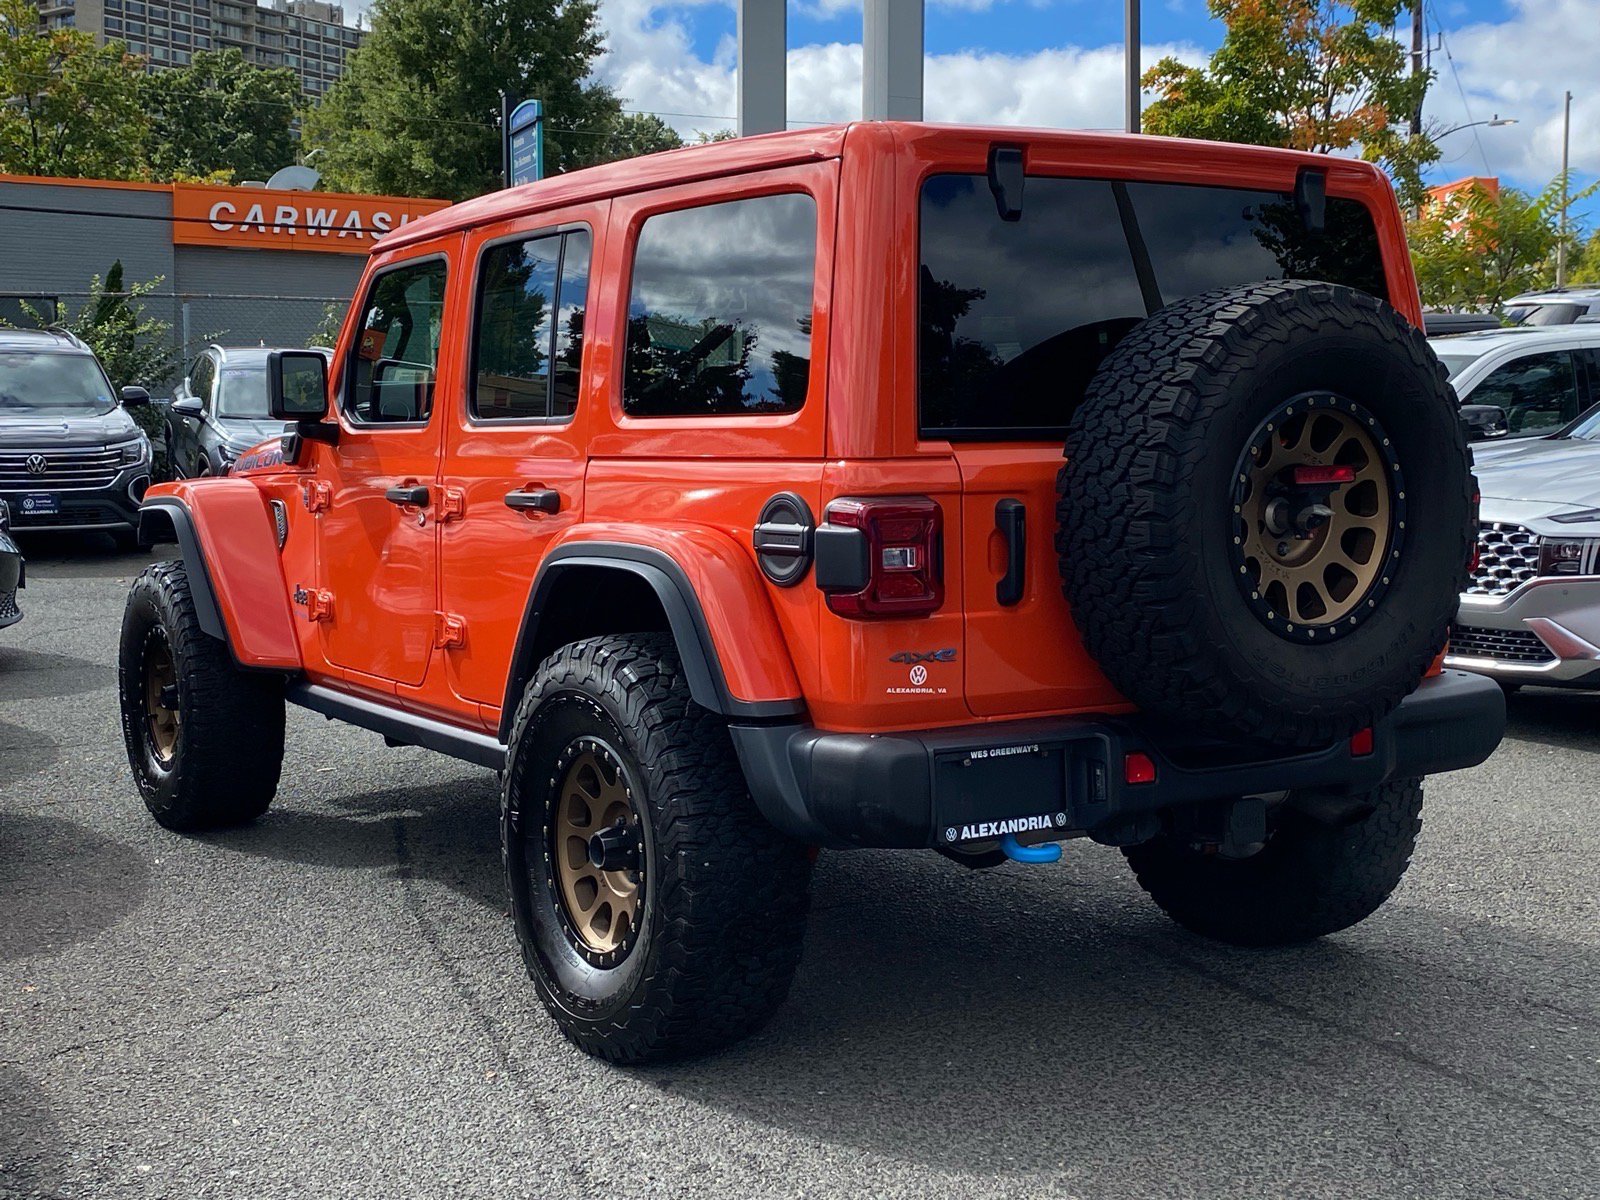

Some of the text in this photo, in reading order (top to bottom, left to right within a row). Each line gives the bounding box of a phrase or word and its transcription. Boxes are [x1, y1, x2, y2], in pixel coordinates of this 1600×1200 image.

[970, 744, 1039, 759] WES GREENWAY'S
[960, 815, 1053, 840] ALEXANDRIA
